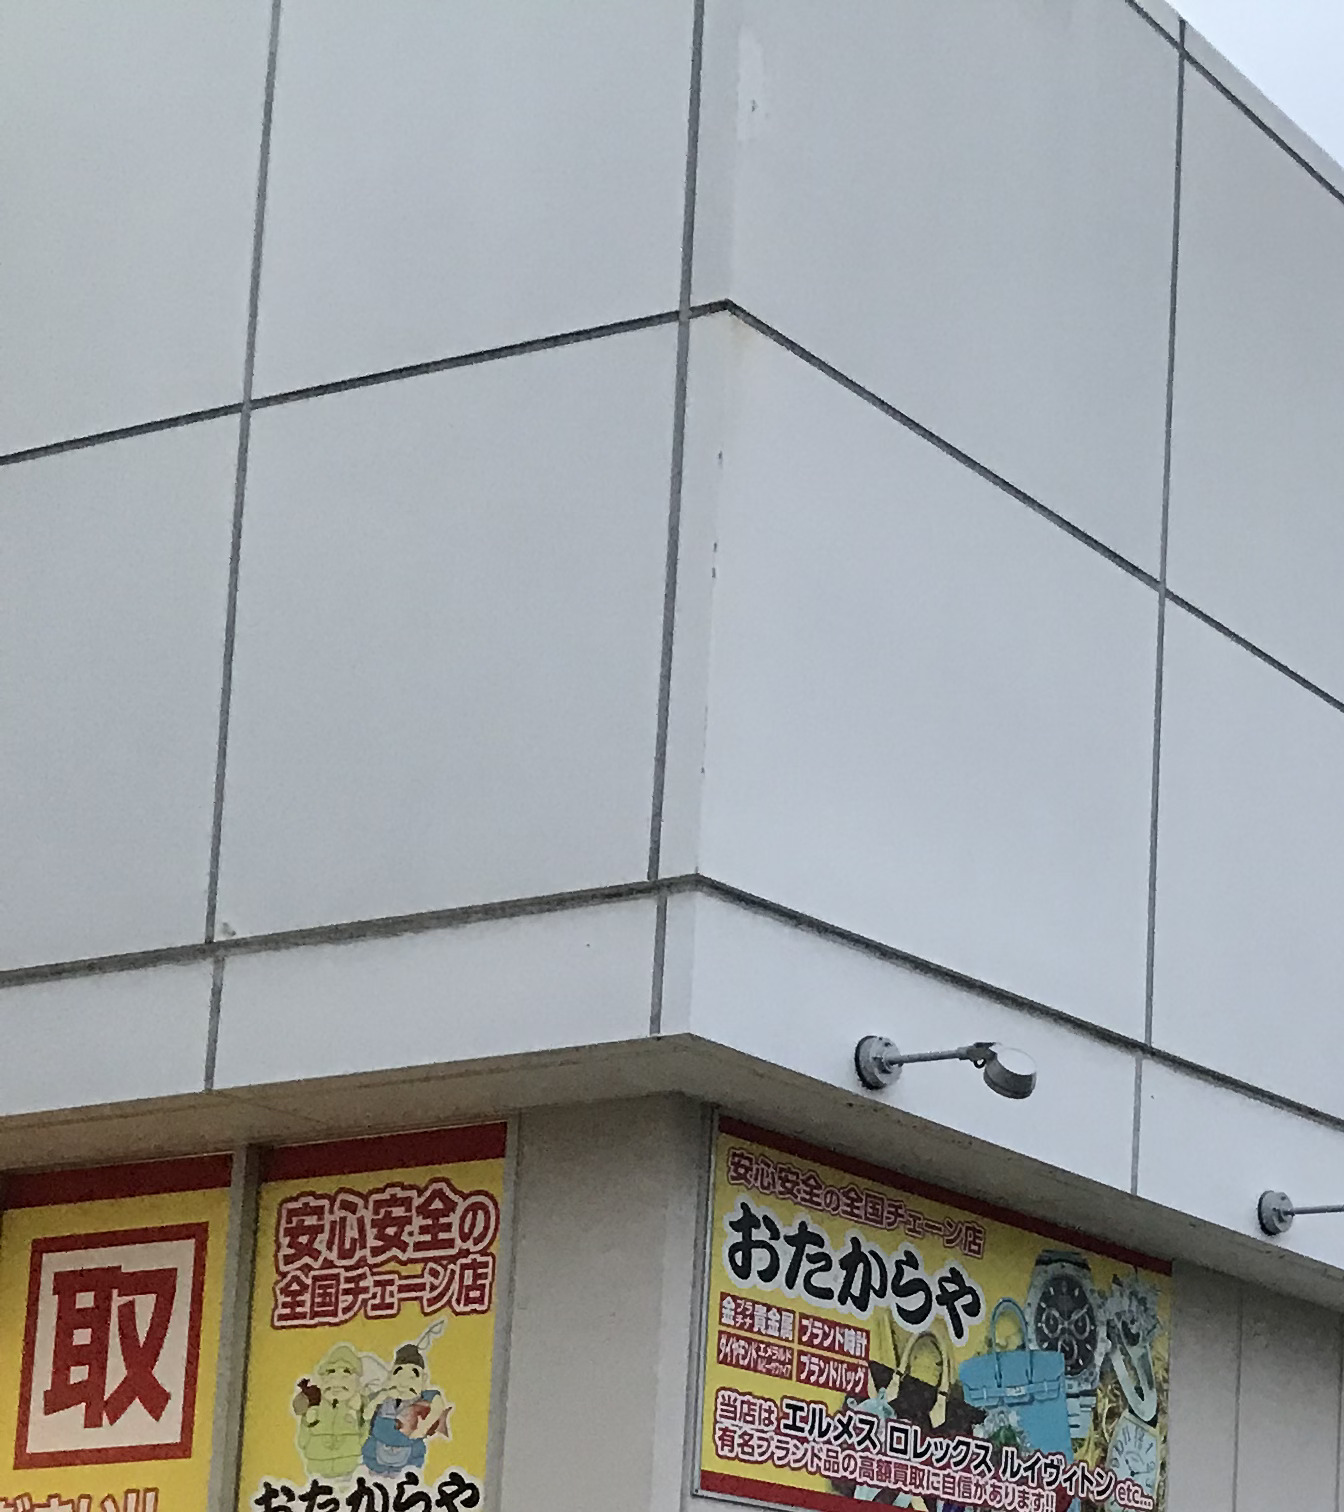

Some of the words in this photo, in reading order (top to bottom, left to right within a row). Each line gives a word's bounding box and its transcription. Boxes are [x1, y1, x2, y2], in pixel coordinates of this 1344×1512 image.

[277, 1181, 498, 1268] 安心安全の
[728, 1149, 985, 1259] 安心安全の全国チェーン店
[273, 1255, 494, 1328] 全国チェーン店
[728, 1201, 982, 1340] おたからや
[43, 1265, 177, 1428] 取
[800, 1353, 866, 1394] ブランドバッグ
[716, 1389, 777, 1431] 当店は
[781, 1398, 880, 1451] エルメス
[886, 1421, 994, 1478] ロレックス
[1000, 1446, 1116, 1501] ルイヴィトン
